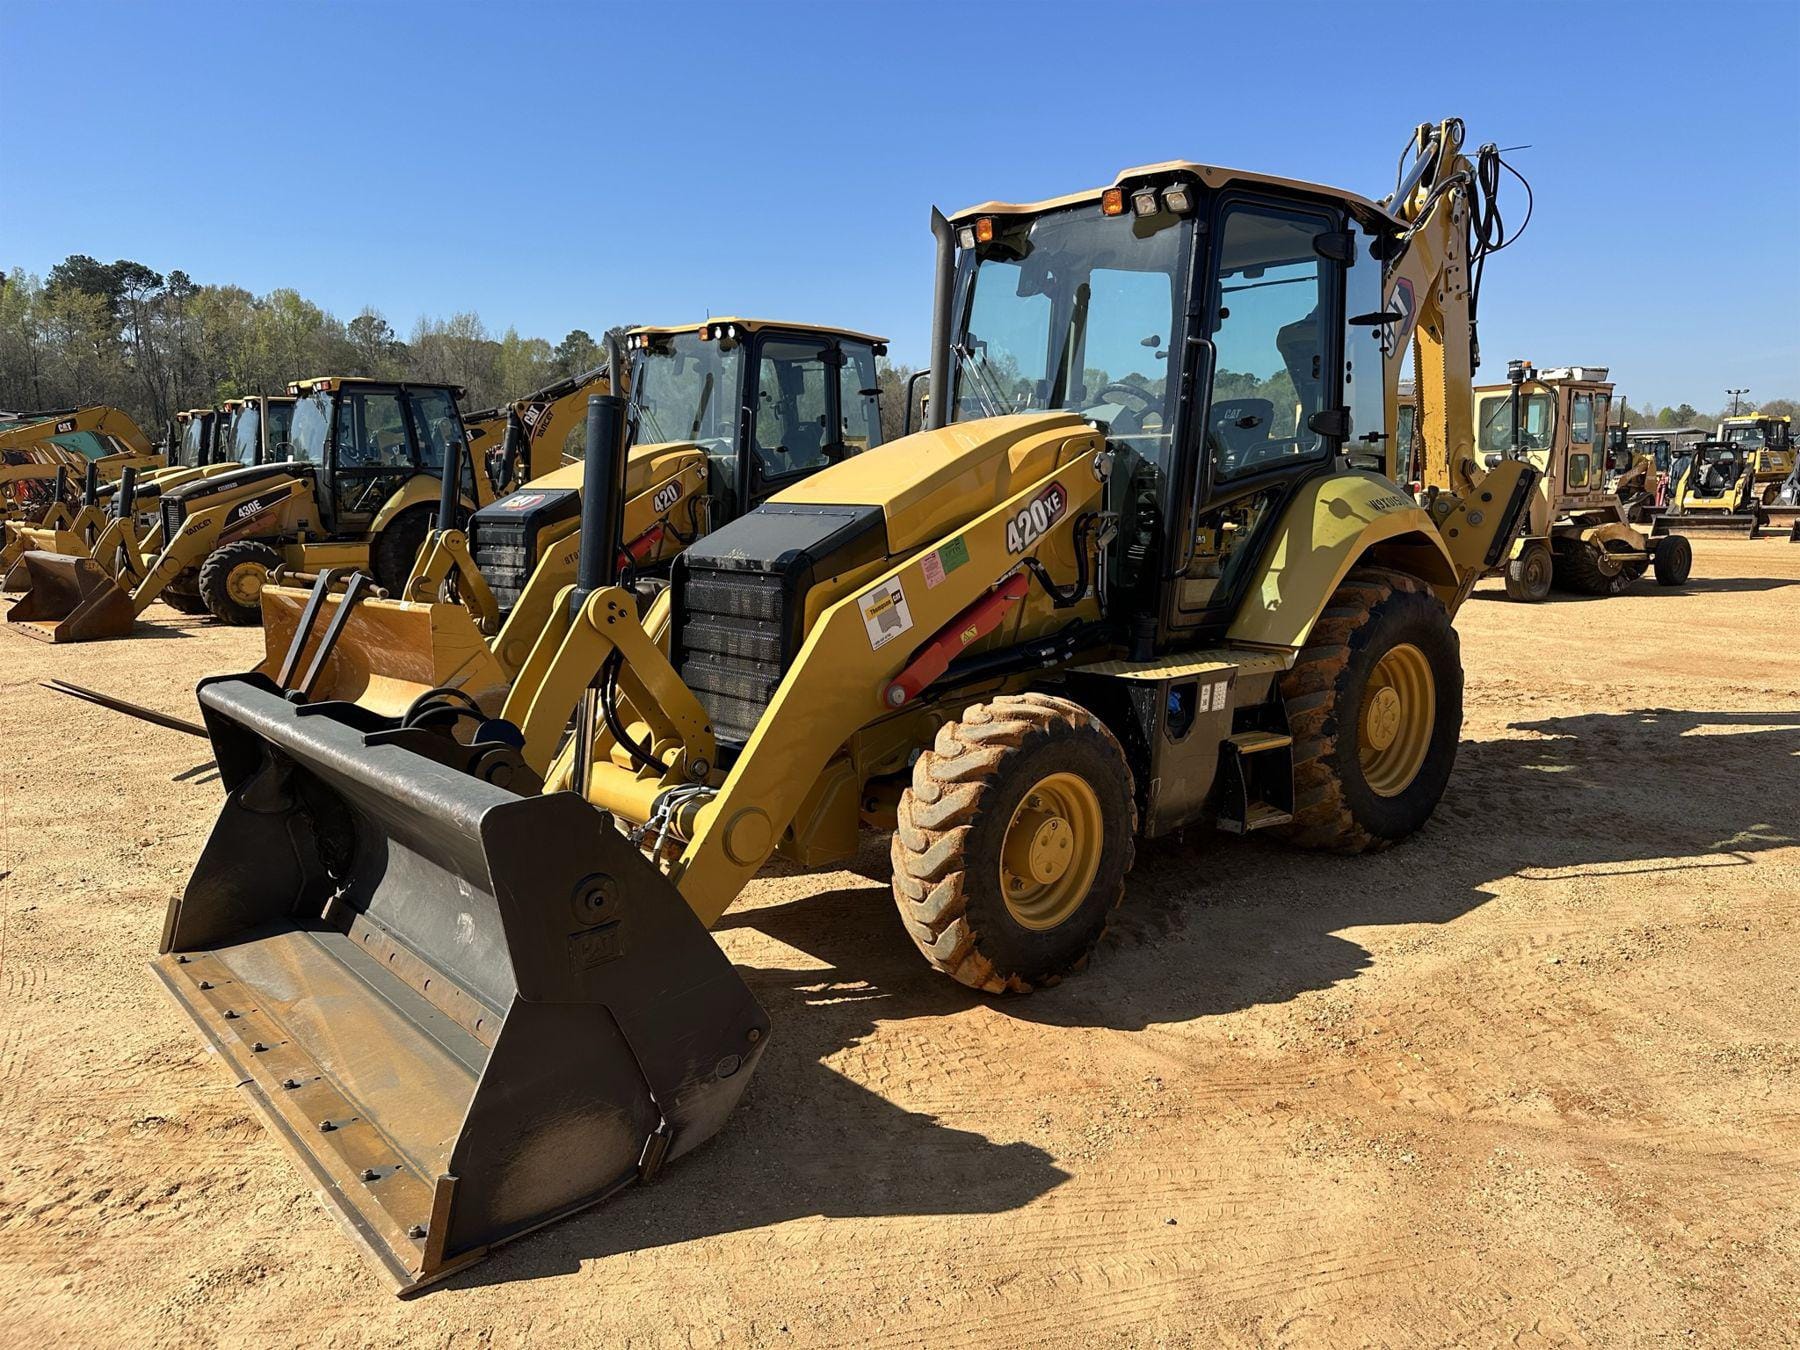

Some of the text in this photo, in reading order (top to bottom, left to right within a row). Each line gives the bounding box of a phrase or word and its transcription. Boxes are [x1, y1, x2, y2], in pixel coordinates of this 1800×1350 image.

[524, 405, 540, 426] CAT
[1224, 408, 1242, 419] CAT
[57, 422, 73, 432] CAT
[537, 410, 554, 438] YANCEY
[654, 485, 678, 511] 420
[238, 500, 262, 517] 430E
[184, 518, 212, 536] YANCEY
